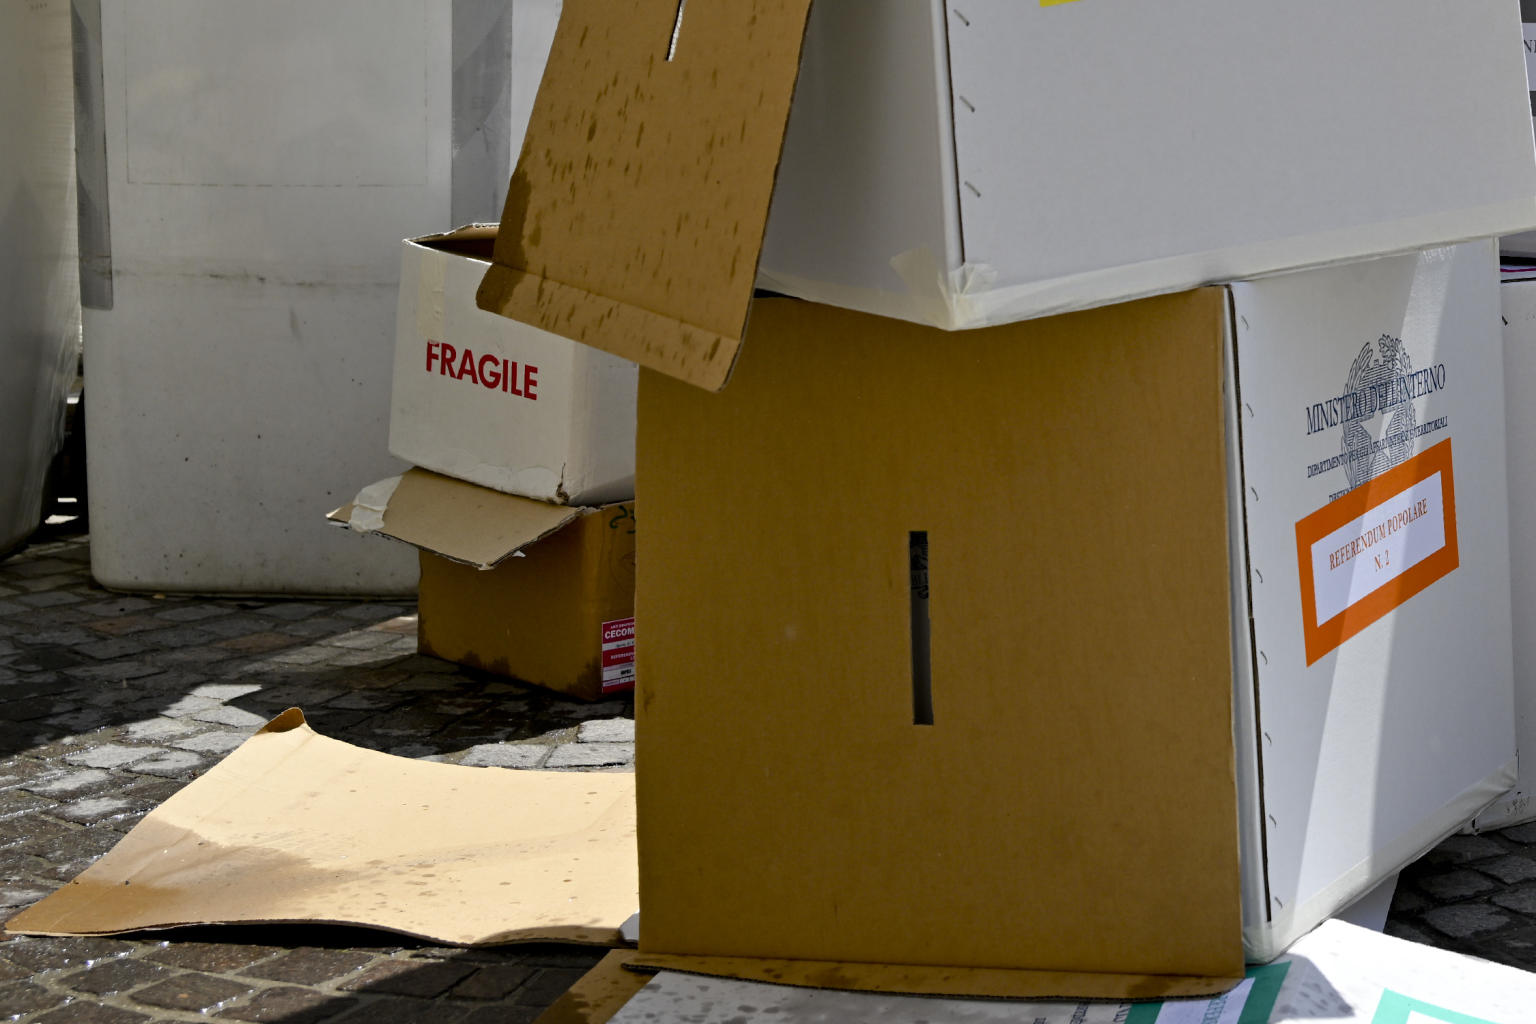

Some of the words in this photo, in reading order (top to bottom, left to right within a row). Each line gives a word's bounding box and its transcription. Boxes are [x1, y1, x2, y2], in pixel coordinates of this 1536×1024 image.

[425, 339, 538, 401] FRAGILE
[1306, 388, 1367, 436] MINISTERO
[1369, 363, 1446, 414] DELL'INTERNO
[1307, 453, 1348, 479] DIPARTIMENTO
[1328, 522, 1386, 571] REFERENDUM
[1387, 497, 1428, 537] POPOLARE
[1374, 555, 1384, 572] N.
[1385, 550, 1390, 566] 2
